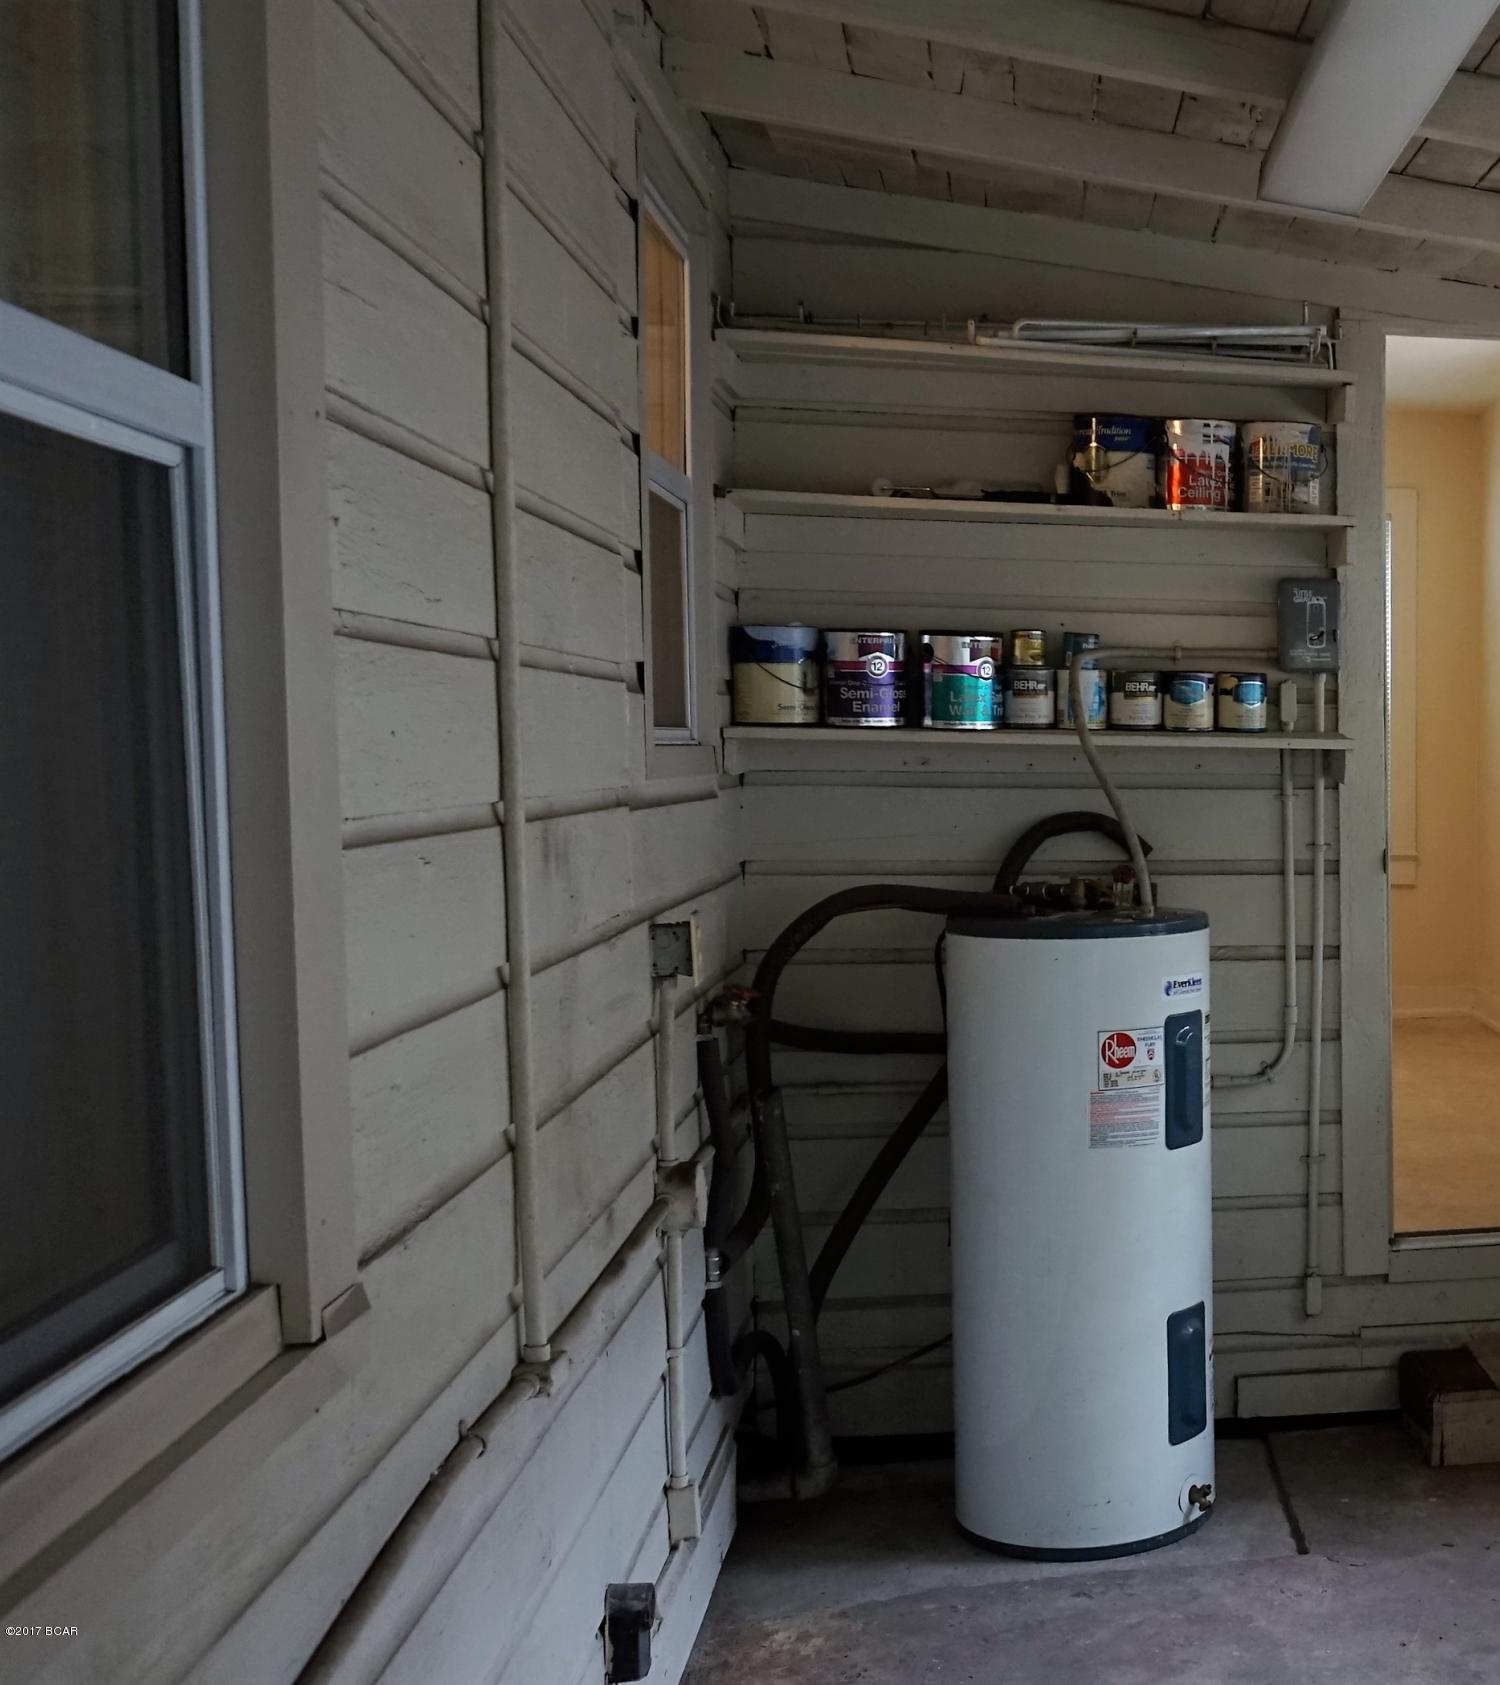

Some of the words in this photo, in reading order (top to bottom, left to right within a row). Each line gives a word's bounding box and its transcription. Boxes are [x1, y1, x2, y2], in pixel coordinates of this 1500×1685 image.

[1178, 486, 1221, 502] Ceiling
[873, 662, 884, 672] 12
[982, 666, 992, 676] 12
[1014, 680, 1038, 690] BEHR
[1125, 681, 1149, 692] BEHR
[852, 700, 901, 713] Enamel
[1105, 1034, 1136, 1065] Rheem
